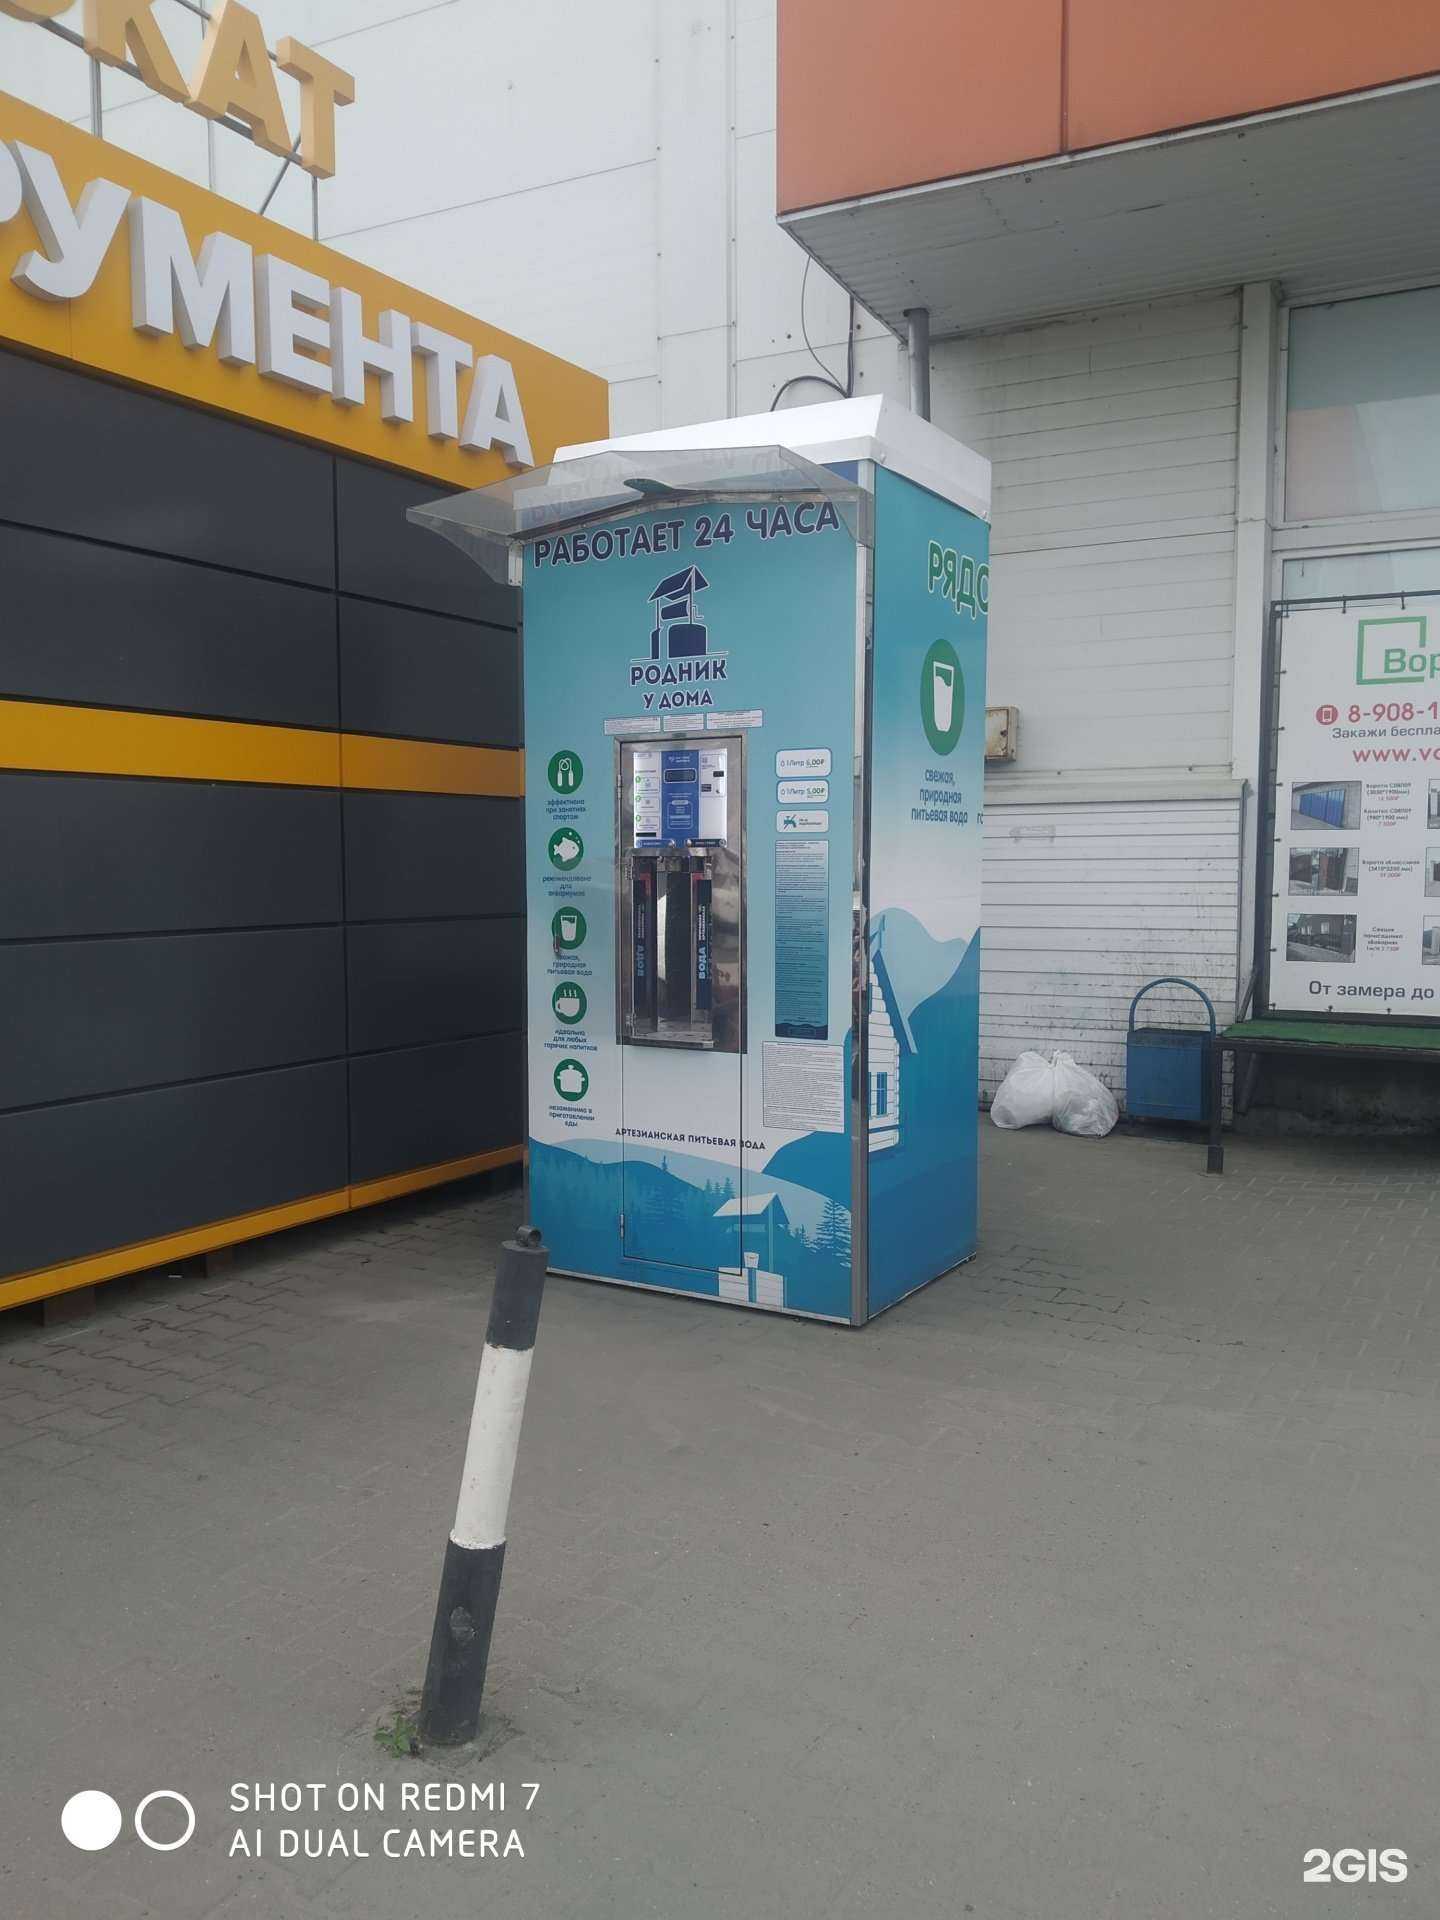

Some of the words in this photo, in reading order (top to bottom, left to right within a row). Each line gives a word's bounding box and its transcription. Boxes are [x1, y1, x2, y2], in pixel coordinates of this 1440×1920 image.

[0, 0, 356, 180] КАТ
[534, 520, 685, 569] РАБОТАЕТ
[694, 512, 735, 548] 24
[745, 500, 841, 540] ЧАСА
[630, 659, 728, 686] РОДНИК
[643, 692, 655, 710] У
[658, 689, 714, 710] ДОМА
[1348, 701, 1438, 723] 8-908-1
[1332, 727, 1387, 739] Закажи
[925, 768, 956, 786] свежая,
[919, 788, 962, 806] природная
[911, 807, 948, 822] питьевая
[949, 810, 968, 826] вода
[1309, 981, 1332, 995] От
[1336, 985, 1406, 1001] замера
[1411, 987, 1434, 1001] до
[615, 1128, 685, 1142] АРТЕЗИАНСКАЯ
[688, 1135, 736, 1147] ПИТЬЕВАЯ
